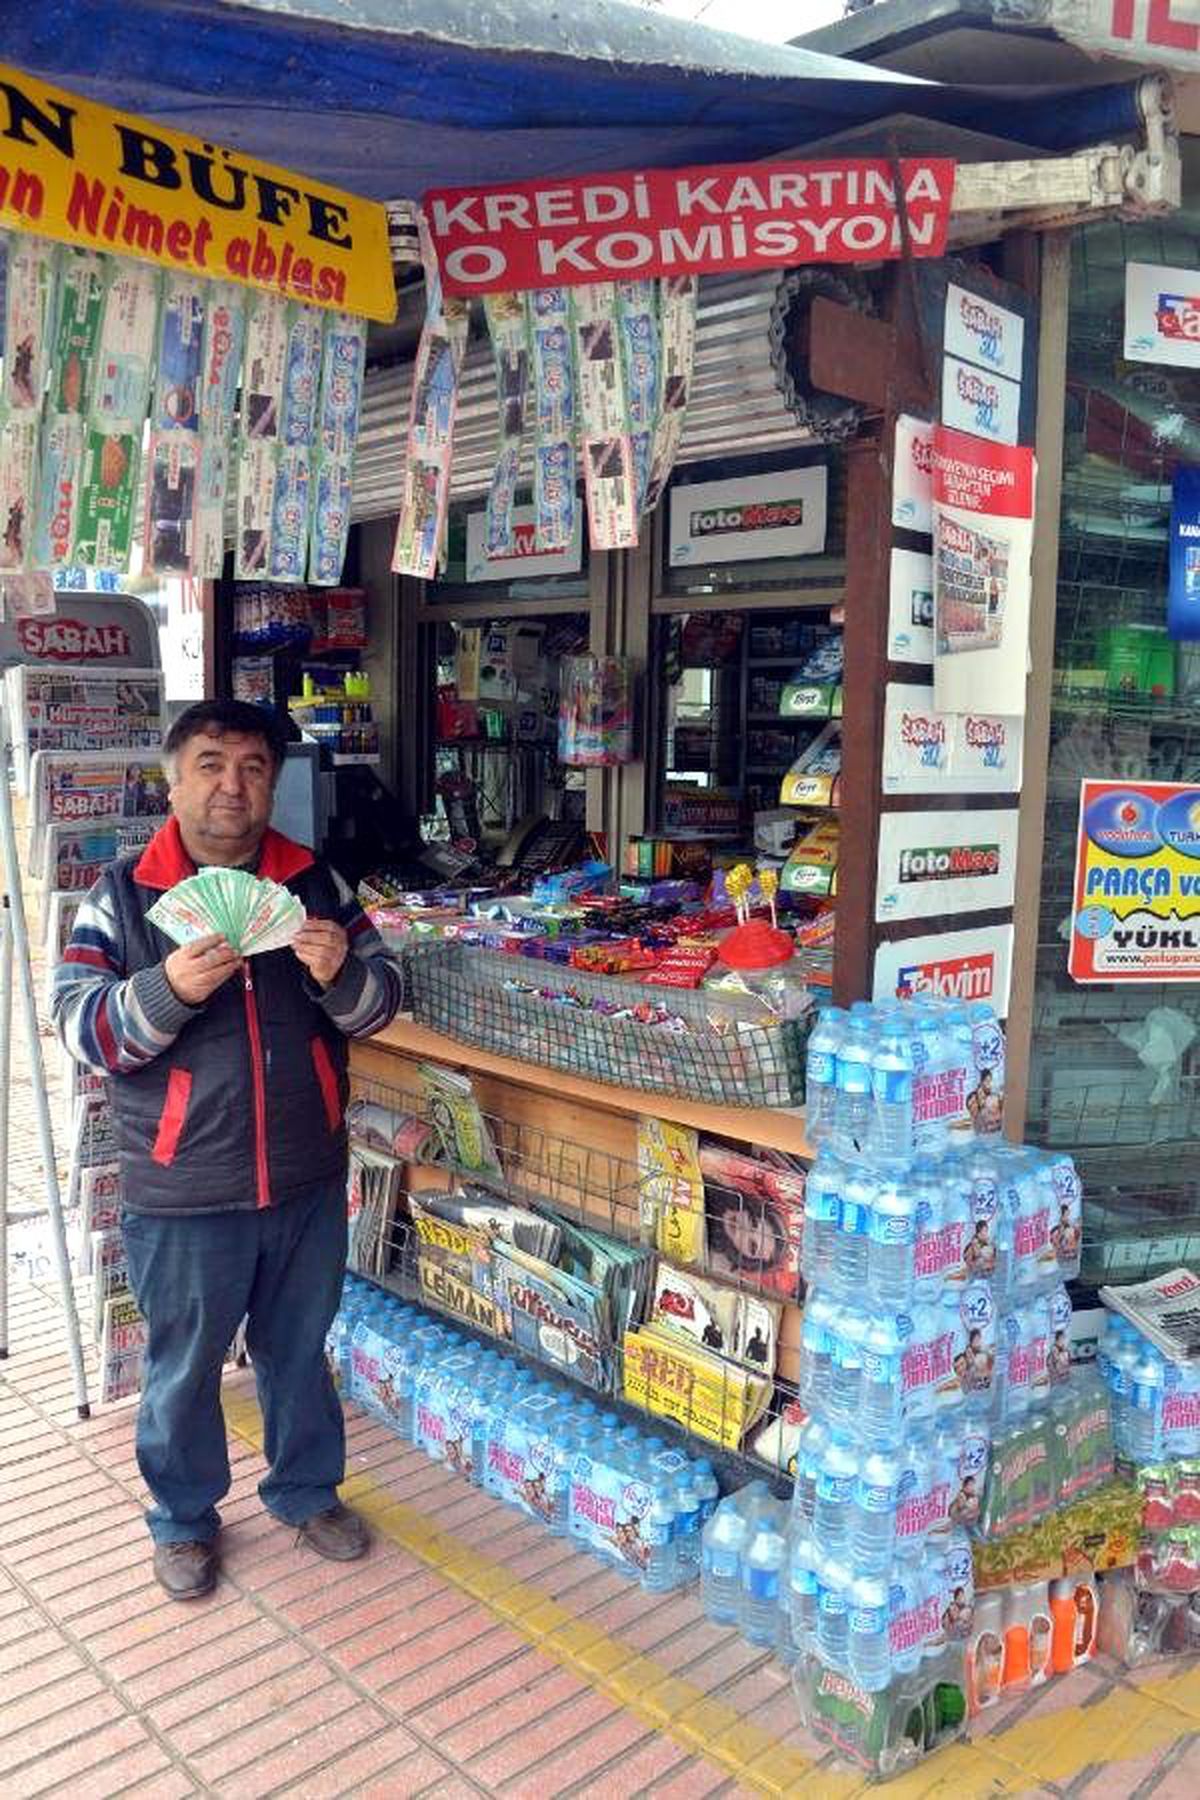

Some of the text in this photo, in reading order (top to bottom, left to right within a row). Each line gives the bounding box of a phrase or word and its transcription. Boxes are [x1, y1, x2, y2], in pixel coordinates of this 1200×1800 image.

[113, 124, 353, 250] BÜFE
[436, 167, 941, 236] KREDİ KARTINA
[67, 172, 213, 268] Nimet
[226, 228, 347, 306] ablası
[537, 213, 936, 275] KOMİSYON
[22, 618, 129, 659] SABAH
[1087, 866, 1171, 905] PARÇA
[423, 1265, 494, 1329] LEMAN
